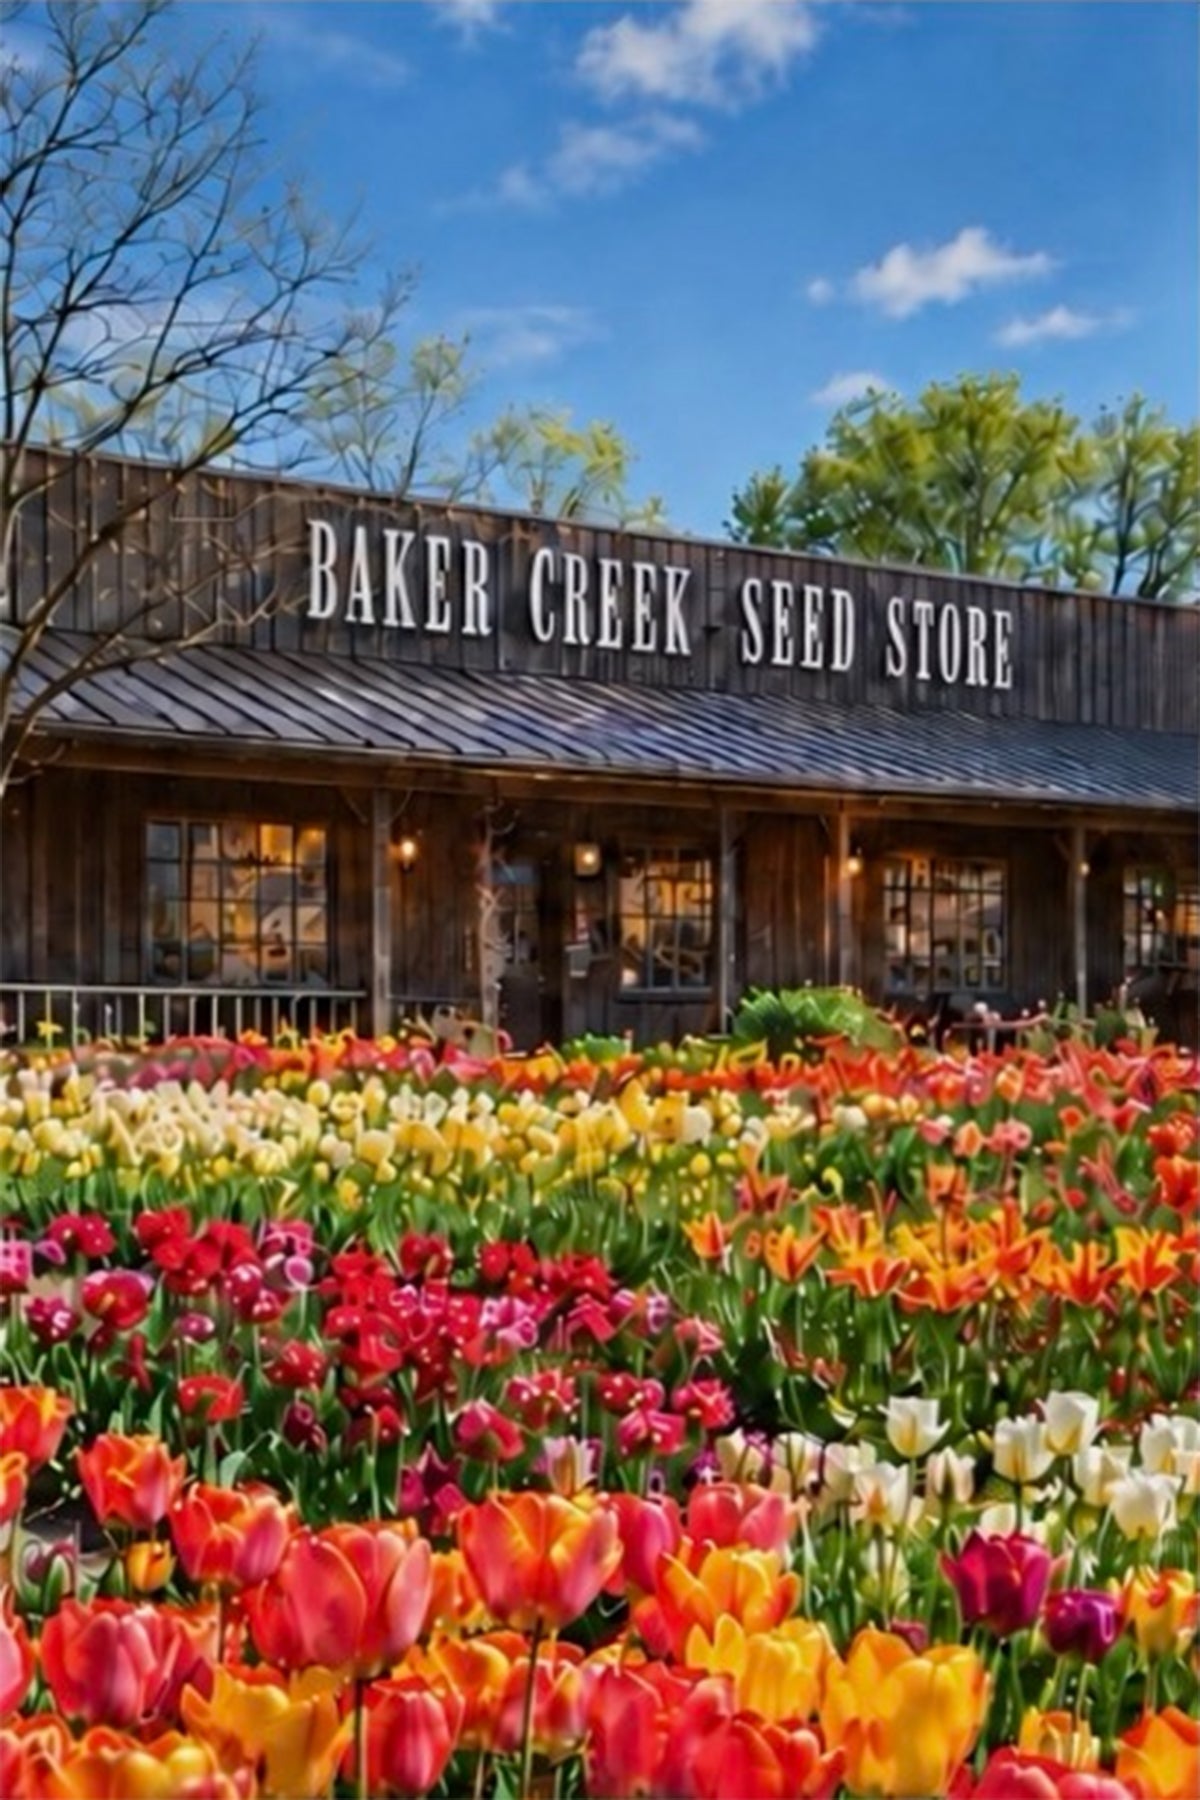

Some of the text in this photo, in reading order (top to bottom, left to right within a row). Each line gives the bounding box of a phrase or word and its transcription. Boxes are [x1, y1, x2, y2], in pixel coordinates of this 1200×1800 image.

[306, 519, 1015, 691] BAKER CREEK SEED STORE
